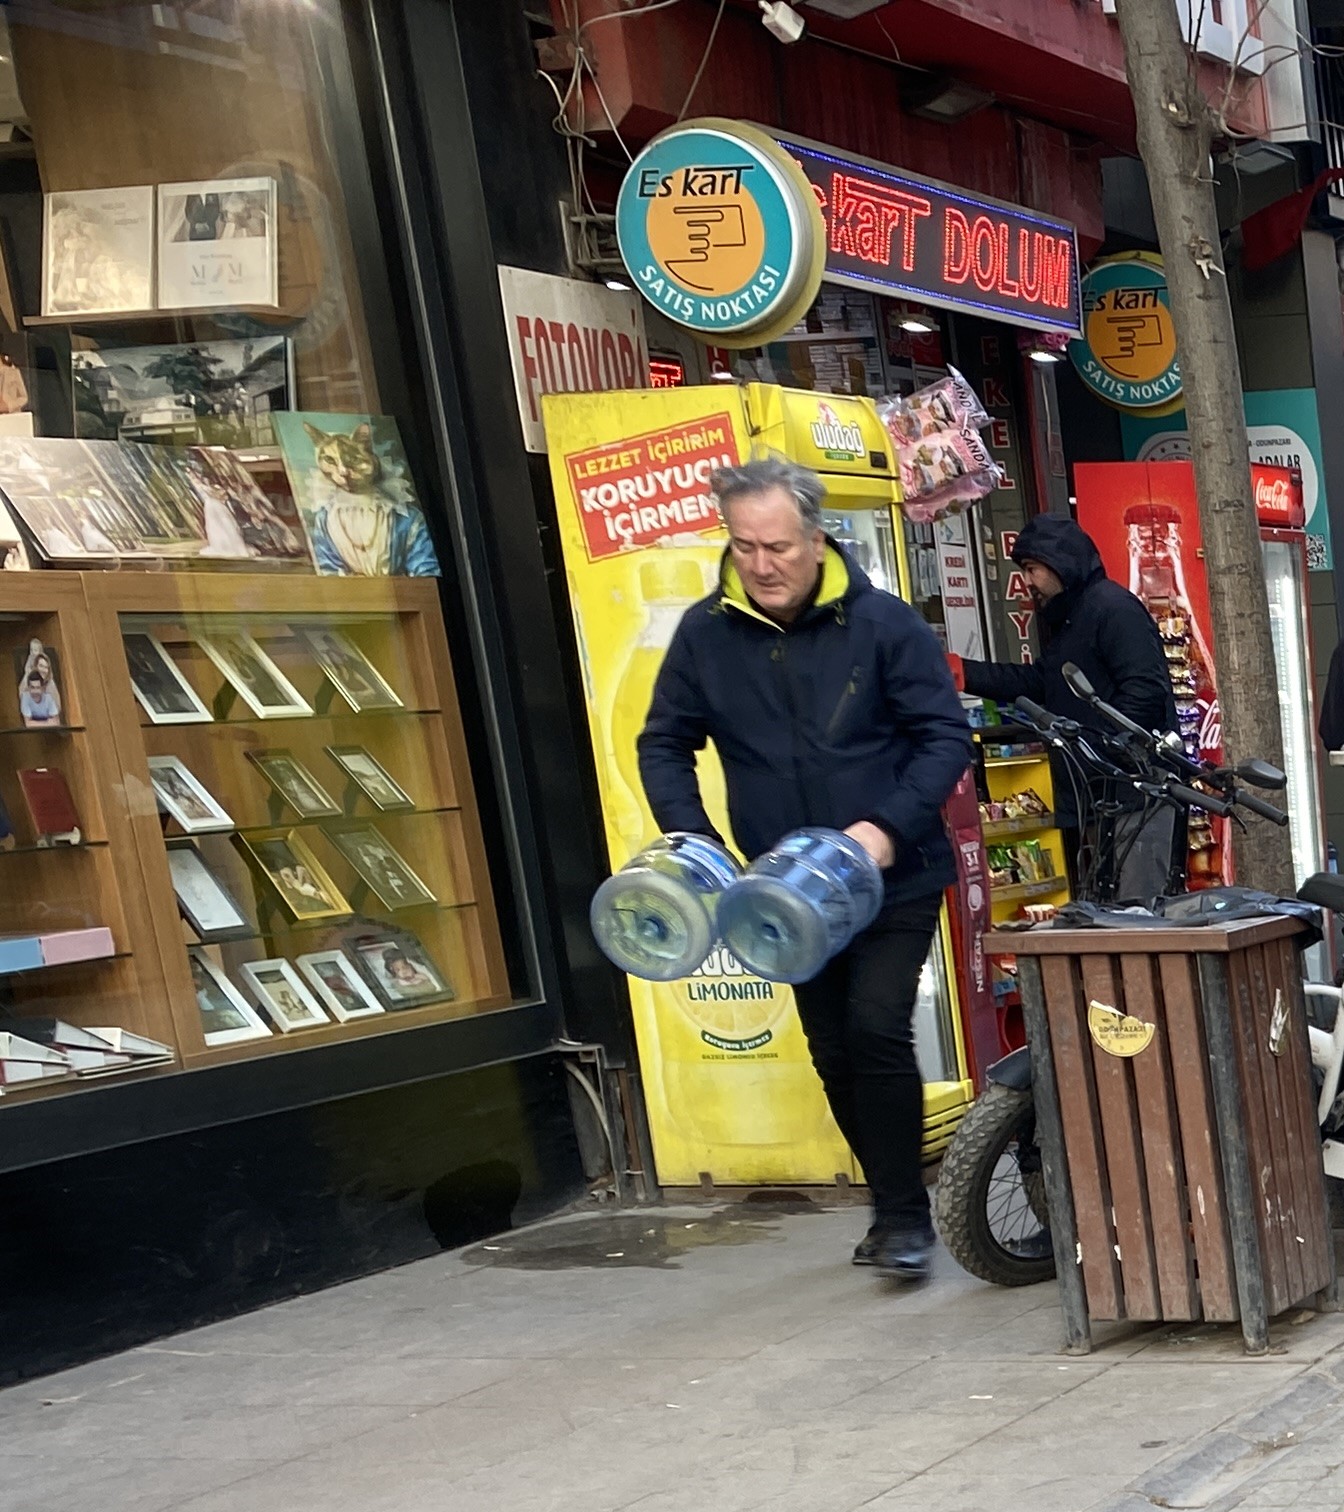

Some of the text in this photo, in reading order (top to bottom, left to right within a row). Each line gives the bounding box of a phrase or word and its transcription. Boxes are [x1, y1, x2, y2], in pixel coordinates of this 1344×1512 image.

[638, 168, 673, 198] Es
[943, 207, 1071, 310] DOLUM
[639, 264, 780, 321] SATIŞ NOKTASI
[1082, 360, 1181, 401] SATIŞ NOKTAS
[574, 425, 725, 480] LEZZET İÇİRİRİM
